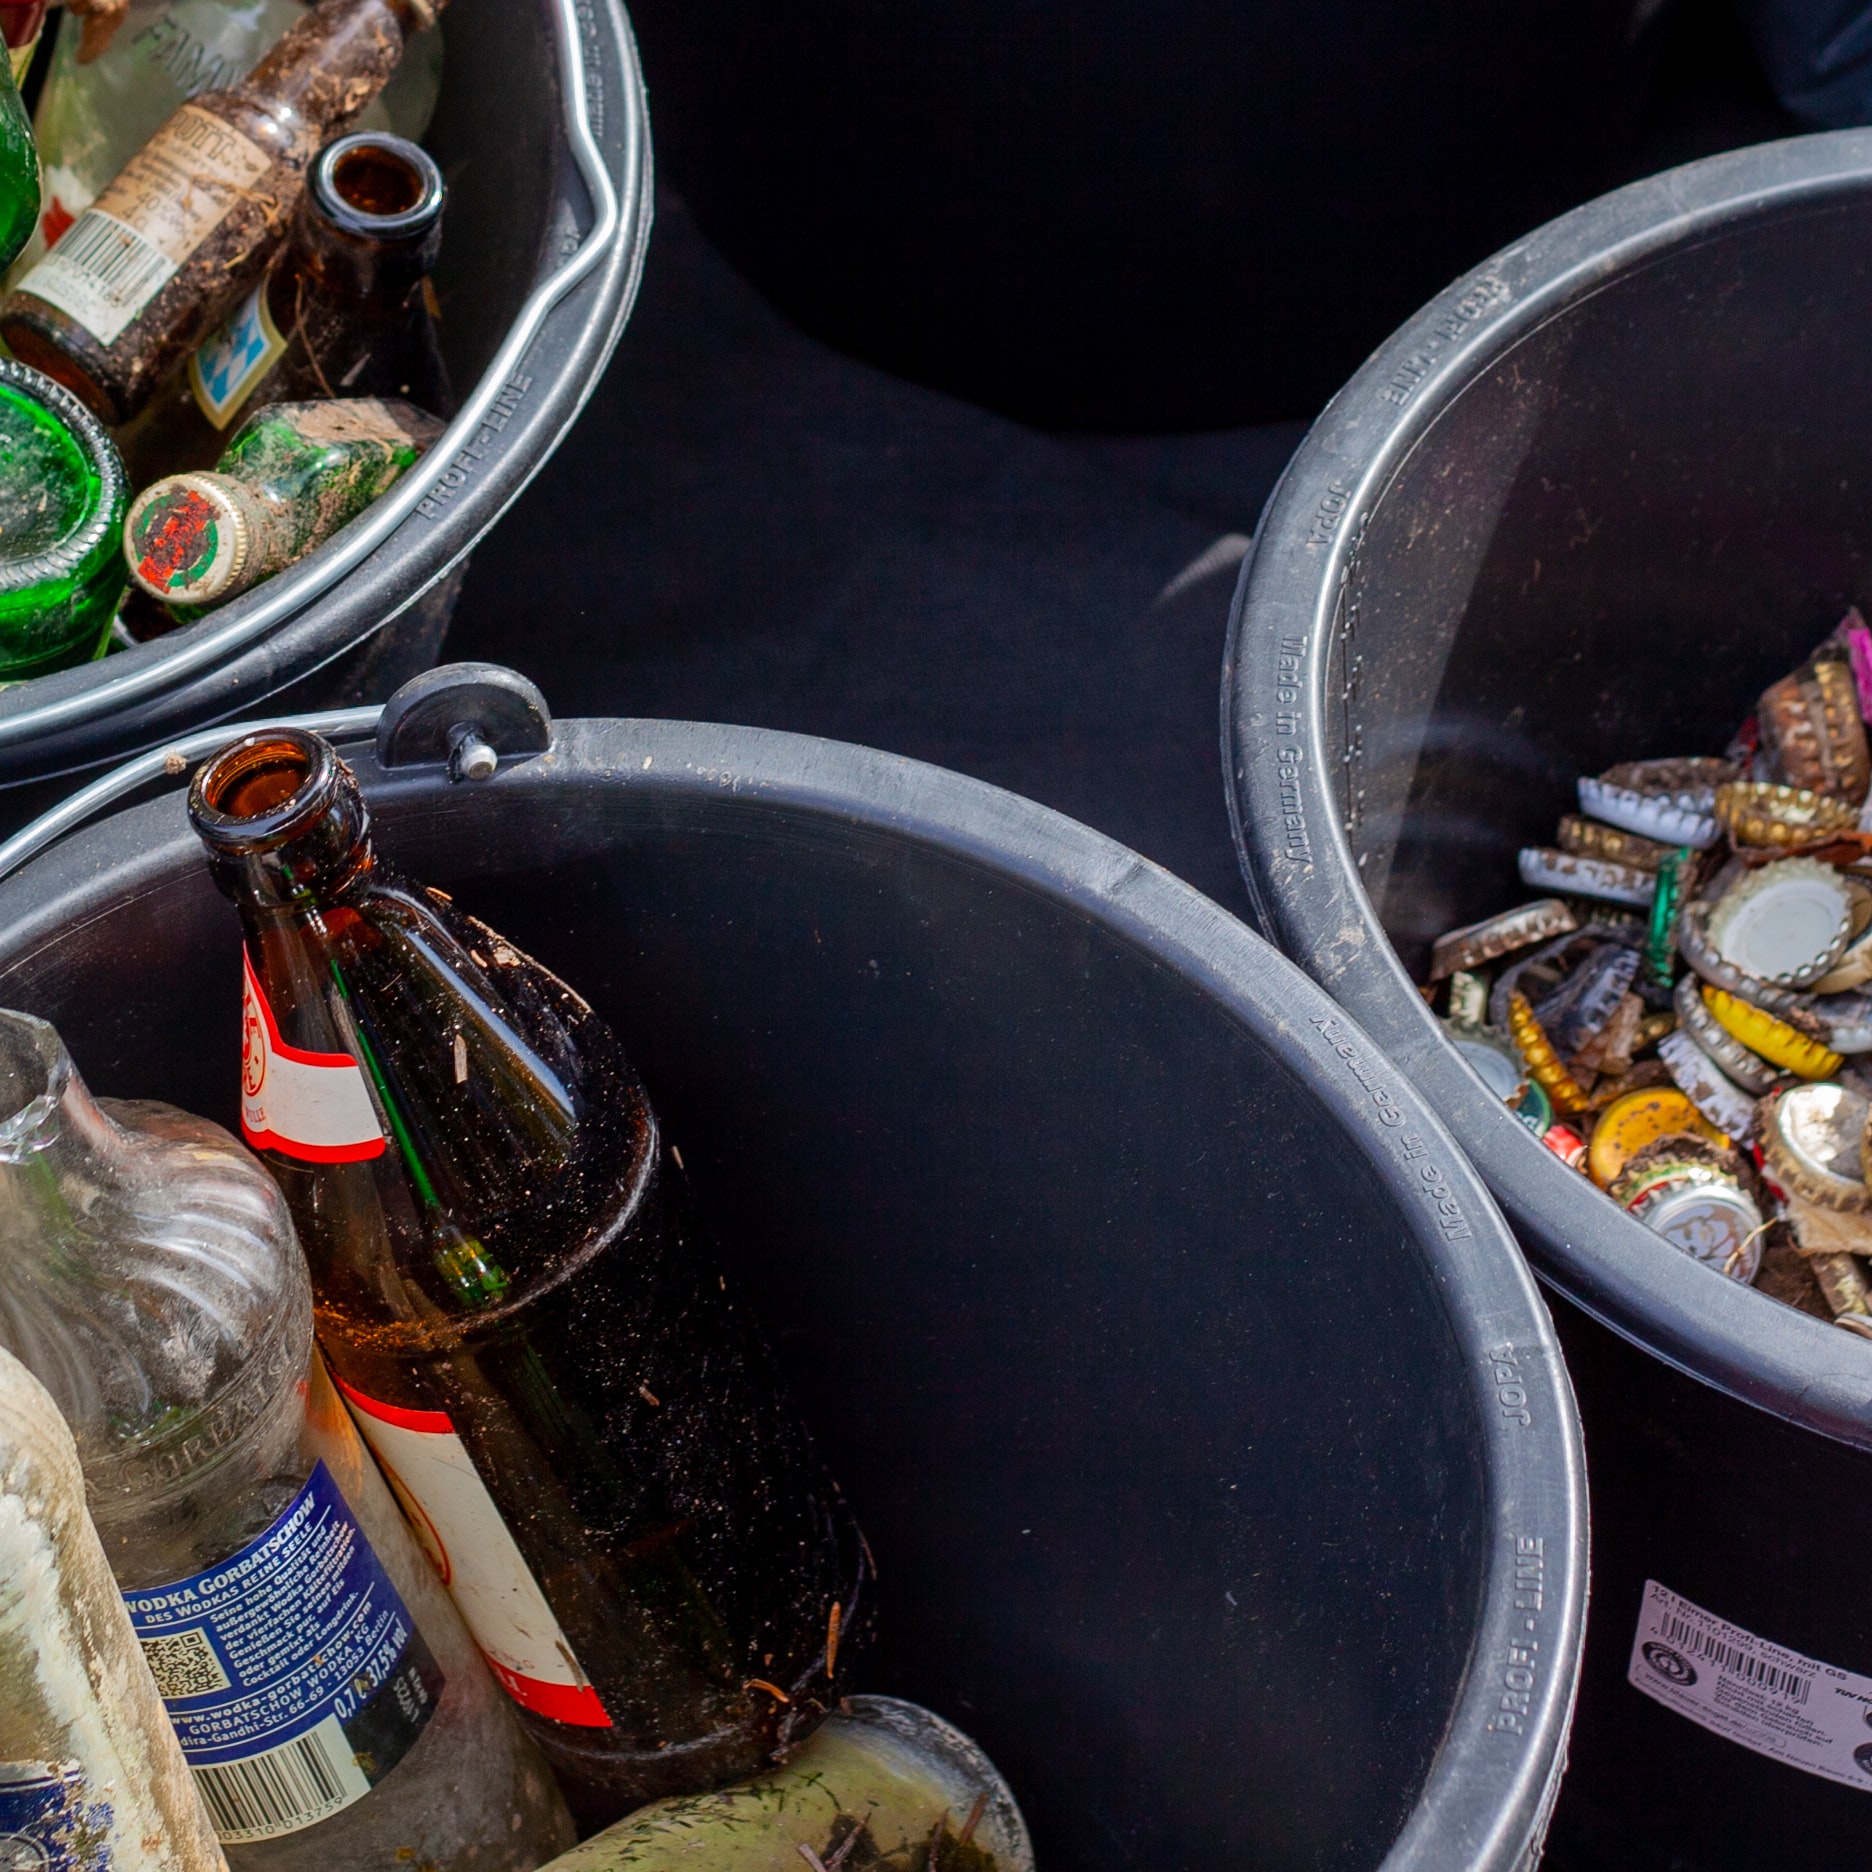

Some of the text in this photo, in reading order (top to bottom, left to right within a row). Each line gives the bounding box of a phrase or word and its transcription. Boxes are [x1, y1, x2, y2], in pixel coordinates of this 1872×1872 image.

[1277, 744, 1314, 865] Germany
[1308, 1015, 1474, 1243] Made in Germany
[1489, 1341, 1532, 1427] JOPA
[145, 1520, 314, 1625] DES WODKAS REINE SEELE
[198, 1491, 318, 1595] GORBATSCHOW
[209, 1524, 329, 1624] Seine hohe Qualität und
[215, 1519, 341, 1633] außergewöhnliche Reinheit
[219, 1521, 349, 1642] verdankt Wodka Gorbatschow
[1514, 1536, 1545, 1612] LINE
[225, 1635, 245, 1652] der
[245, 1599, 303, 1644] vierfachen
[229, 1624, 284, 1662] Genießen
[283, 1610, 302, 1631] Sie
[301, 1580, 333, 1615] seinen
[233, 1628, 296, 1670] Geschmack
[316, 1594, 334, 1614] auf
[331, 1577, 346, 1596] Eis
[238, 1619, 322, 1679] oder gemixt als
[241, 1655, 291, 1688] Cocktail
[290, 1639, 316, 1661] oder
[1678, 1600, 1717, 1626] Eimer
[1720, 1623, 1794, 1662] Profi-Line,
[1797, 1657, 1821, 1672] mit
[1825, 1667, 1847, 1680] GS
[188, 1687, 302, 1736] GORBATSCHOW
[306, 1644, 354, 1689] WODKA
[354, 1622, 371, 1644] KG
[287, 1685, 326, 1716] 66-69
[334, 1646, 367, 1683] 13053
[332, 1684, 357, 1721] 0,7
[1497, 1638, 1541, 1738] PROFI
[283, 1795, 344, 1831] 013759
